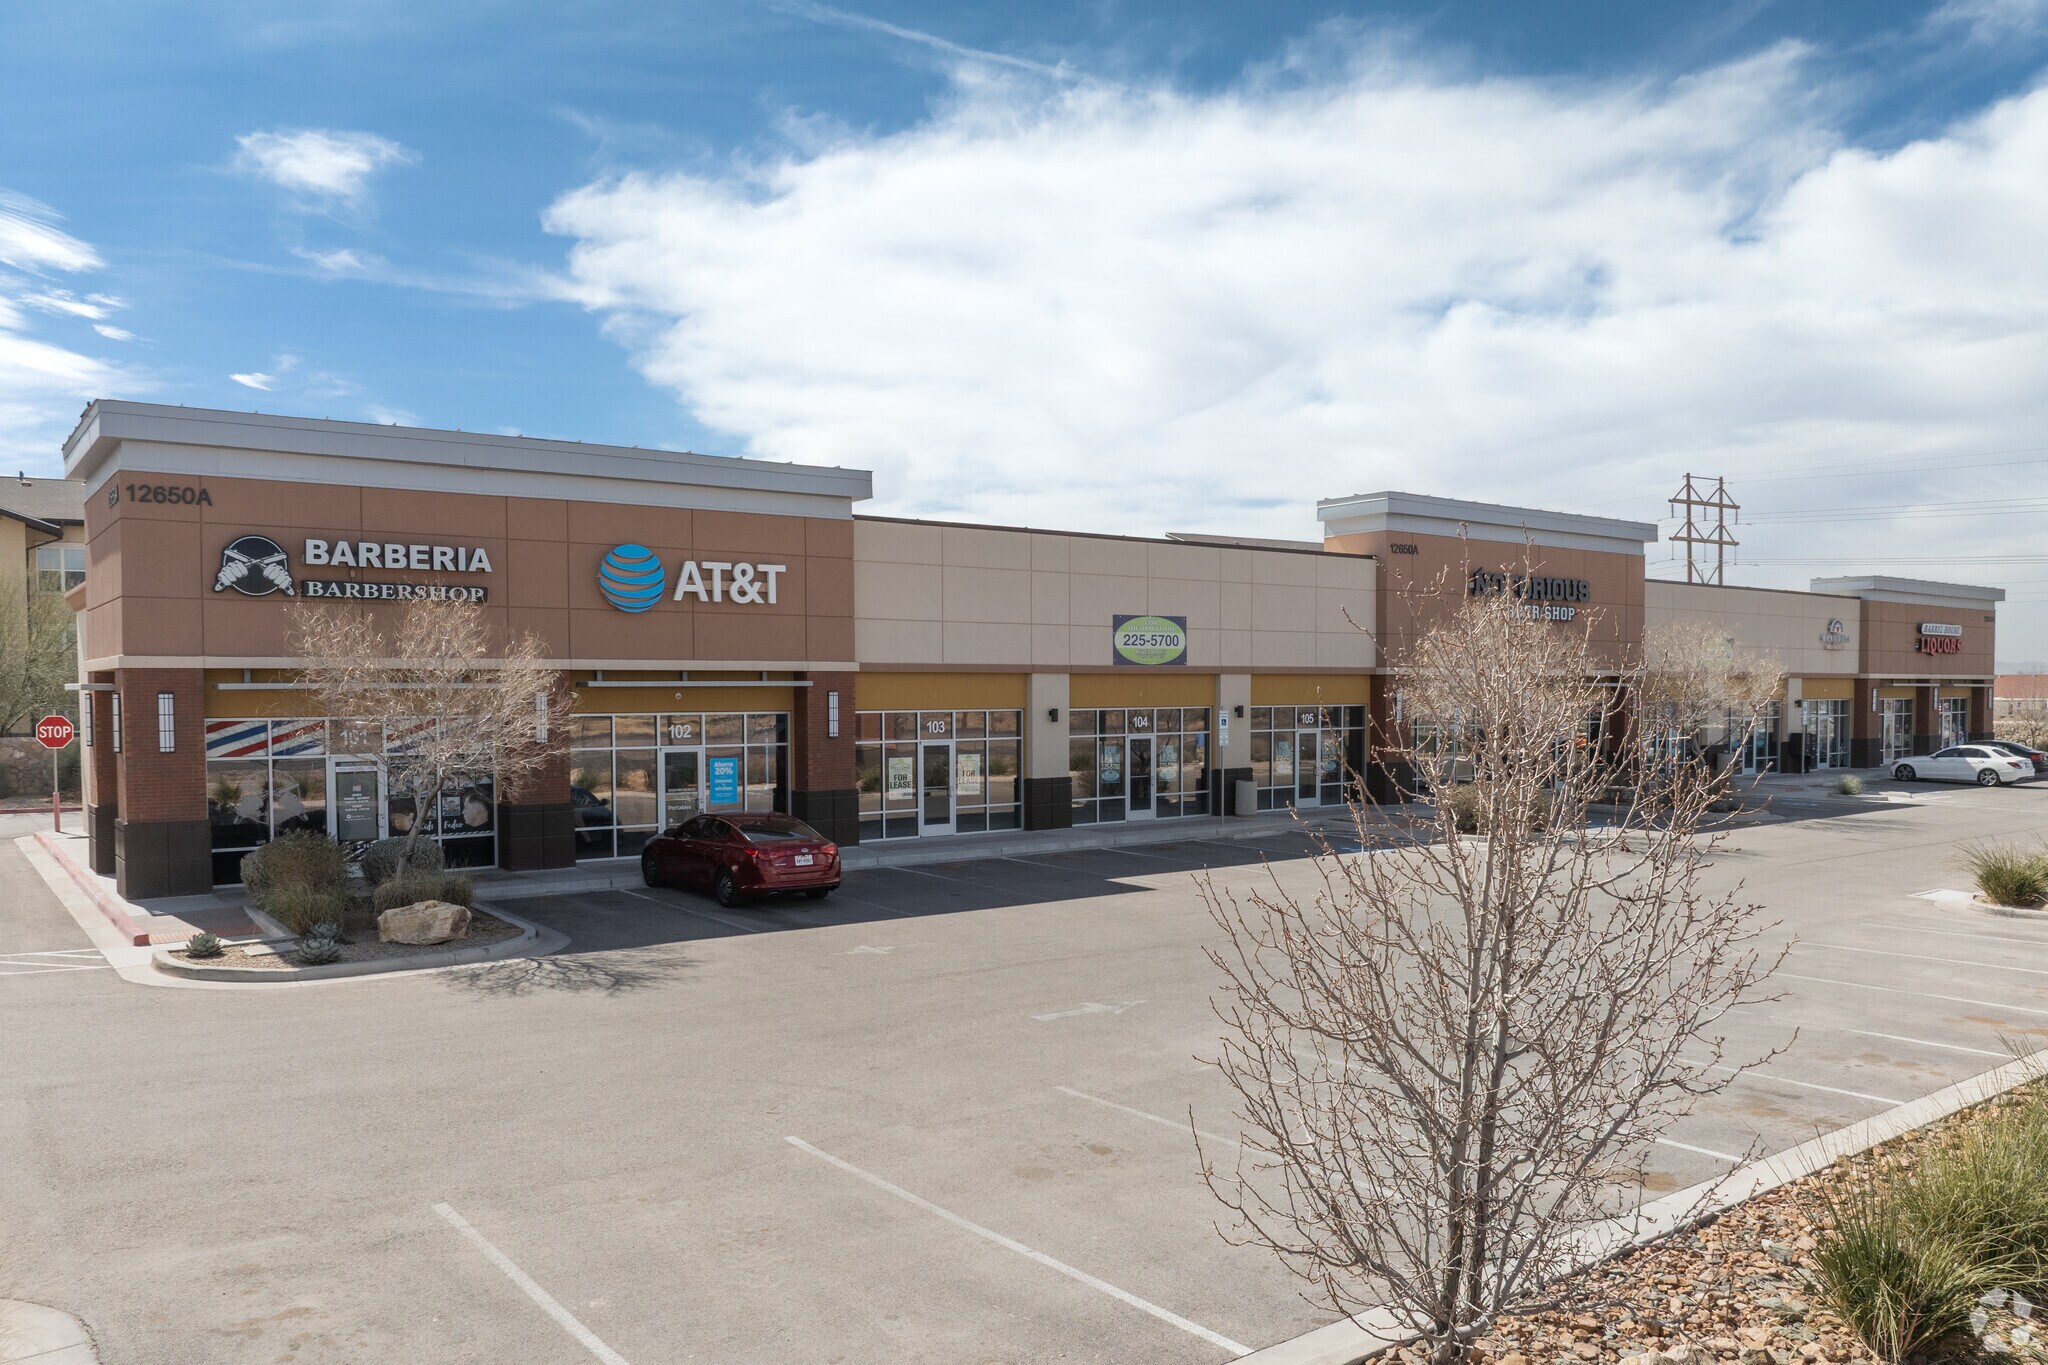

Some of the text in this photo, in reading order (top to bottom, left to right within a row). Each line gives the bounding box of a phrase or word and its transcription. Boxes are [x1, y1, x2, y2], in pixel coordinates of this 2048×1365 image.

[126, 483, 213, 506] 12650A
[1390, 542, 1419, 555] 12650A
[304, 538, 493, 573] BARBERIA
[673, 560, 787, 604] AT&T
[307, 581, 485, 602] BARBERSHOP
[1545, 606, 1575, 620] SHOP
[1923, 625, 1960, 634] BARREL HOUSE
[1123, 634, 1179, 647] 225-5700
[1921, 637, 1963, 656] LIQUORS
[1132, 716, 1148, 728] 104
[1301, 713, 1314, 724] 105
[39, 725, 71, 738] STOP
[668, 724, 691, 739] 102
[927, 721, 945, 733] 103
[715, 767, 733, 775] 20%
[889, 780, 911, 789] LEASE
[958, 777, 978, 785] LEASE
